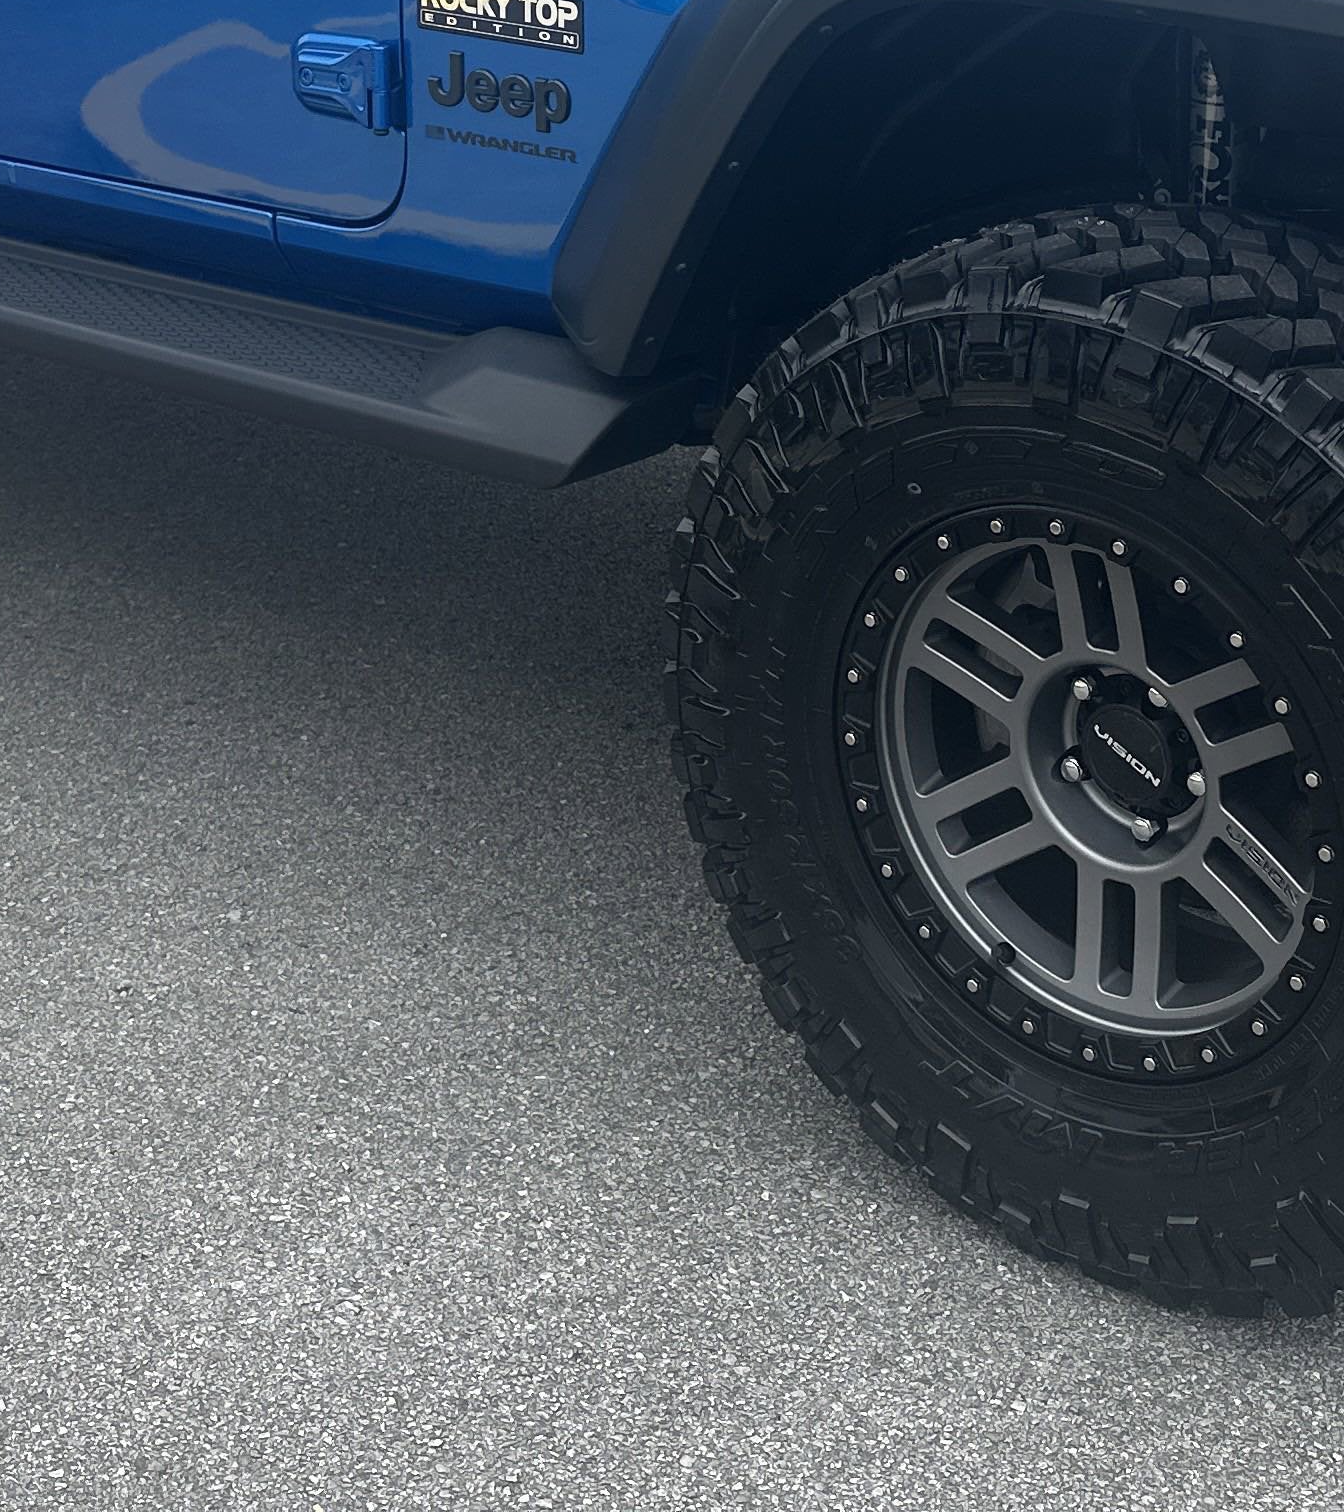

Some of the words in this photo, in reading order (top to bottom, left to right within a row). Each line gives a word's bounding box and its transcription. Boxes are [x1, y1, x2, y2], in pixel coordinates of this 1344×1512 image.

[424, 13, 575, 45] EDITION
[427, 50, 571, 133] Jeep
[446, 128, 578, 164] WRANGLER
[1094, 724, 1161, 787] VISION
[1226, 823, 1298, 907] VISION
